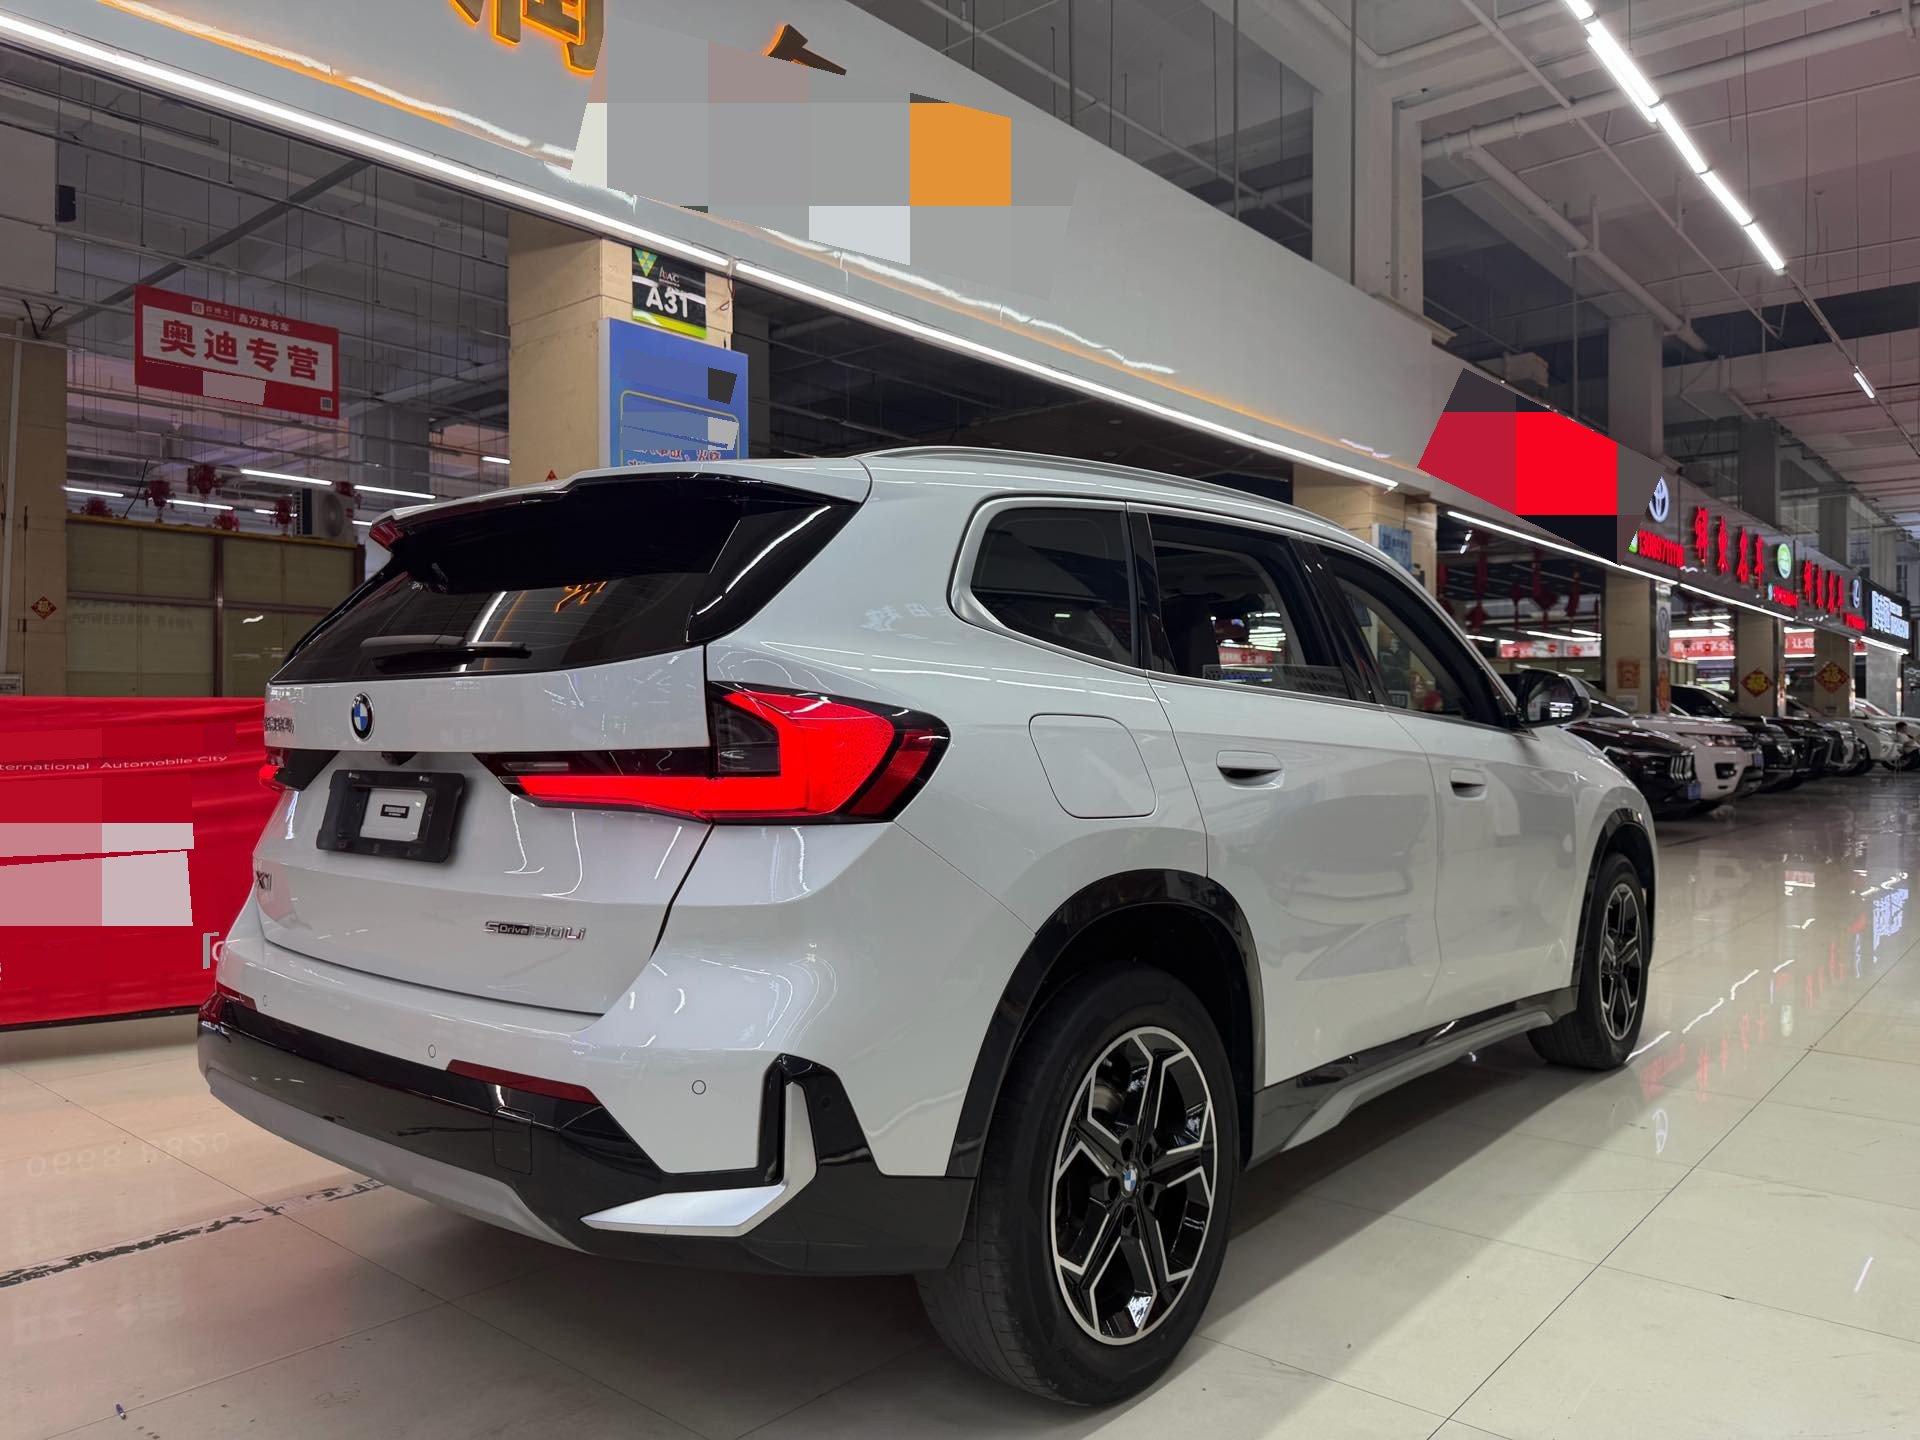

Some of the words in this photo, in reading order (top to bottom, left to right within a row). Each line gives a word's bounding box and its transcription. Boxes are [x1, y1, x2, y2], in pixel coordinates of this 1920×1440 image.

[160, 319, 319, 381] 奥迪专营
[100, 757, 193, 769] Automobile
[197, 755, 228, 764] City
